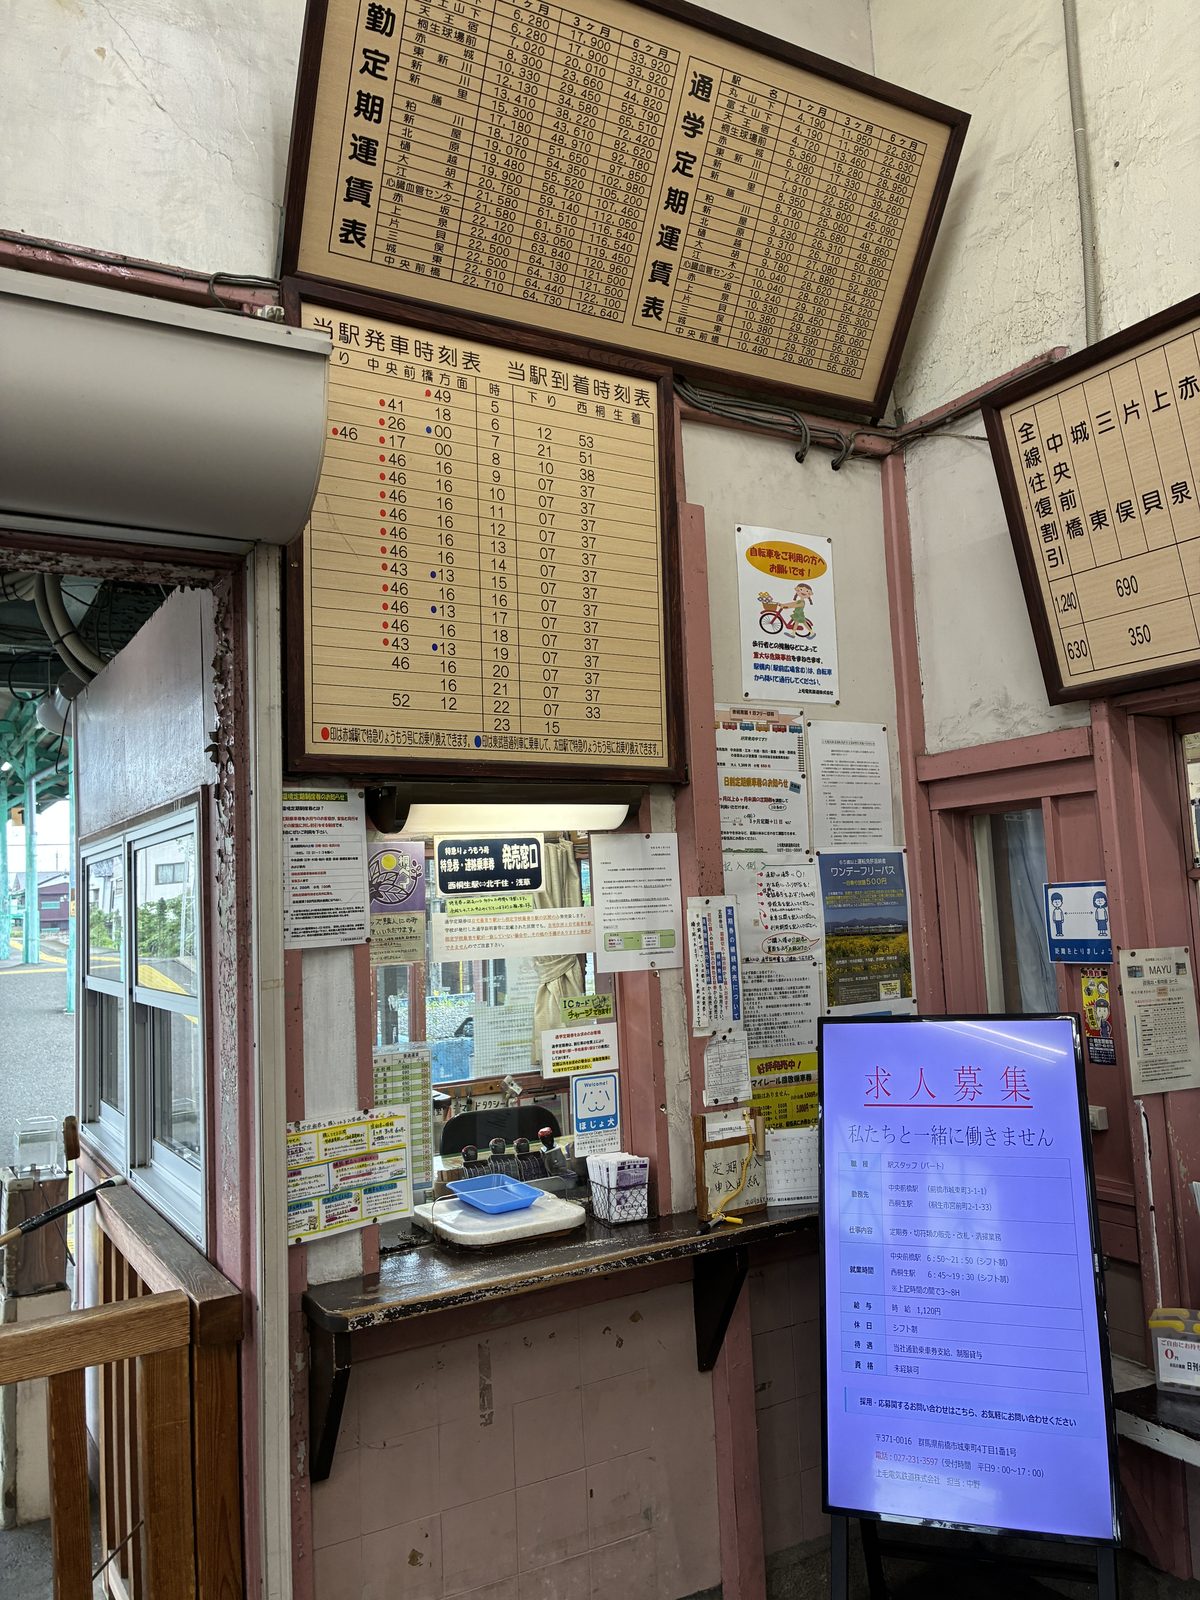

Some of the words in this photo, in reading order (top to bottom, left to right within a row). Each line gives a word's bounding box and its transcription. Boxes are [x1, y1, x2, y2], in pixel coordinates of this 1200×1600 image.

[417, 18, 476, 46] 桐生球場前
[506, 49, 542, 69] 8,300
[562, 68, 603, 89] 23,660
[623, 90, 662, 109] 44,820
[788, 146, 817, 163] 5,360
[833, 162, 863, 179] 15,280
[876, 177, 907, 194] 28,950
[641, 71, 713, 321] 通学定期運賃表
[385, 177, 459, 202] 心臓血管センター
[474, 201, 516, 221] 21,580
[535, 218, 575, 237] 61,510
[589, 234, 632, 252] 116,540
[384, 256, 440, 277] 中央前橋
[462, 274, 503, 292] 22,710
[522, 289, 561, 306] 64,730
[576, 302, 618, 319] 122,640
[313, 317, 480, 372] 当駅発車時刻表
[508, 361, 650, 408] 当駅到着時刻表
[737, 341, 768, 355] 10,490
[782, 352, 813, 365] 29,900
[826, 362, 856, 375] 56,650
[367, 357, 467, 389] 中央前橋方面
[489, 382, 499, 396] 時
[577, 400, 640, 425] 西桐生着
[434, 389, 451, 403] 49
[491, 400, 499, 413] 5
[388, 398, 402, 412] 41
[435, 407, 451, 421] 18
[491, 418, 499, 430] 6
[537, 426, 552, 440] 12
[578, 434, 593, 448] 53
[339, 426, 357, 440] 46
[389, 435, 405, 448] 17
[434, 442, 452, 457] 00
[492, 452, 500, 465] 8
[538, 461, 553, 474] 10
[579, 468, 594, 481] 38
[388, 416, 405, 431] 26
[434, 424, 451, 439] 00
[491, 434, 499, 447] 7
[537, 443, 550, 457] 21
[579, 451, 592, 464] 51
[388, 471, 406, 485] 46
[436, 478, 452, 492] 16
[489, 487, 505, 501] 10
[538, 495, 554, 508] 07
[580, 501, 595, 515] 37
[1018, 422, 1064, 568] 全線往復割引
[1046, 433, 1084, 539] 中央前橋
[749, 546, 825, 566] 自転車をご利用の方へ
[769, 564, 812, 577] お願いです！
[390, 562, 407, 576] 43
[438, 568, 454, 582] 13
[492, 576, 507, 589] 15
[540, 581, 556, 594] 07
[582, 586, 597, 599] 37
[1055, 591, 1077, 613] 1,240
[1115, 575, 1138, 597] 690
[1067, 639, 1087, 659] 630
[1128, 624, 1151, 646] 350
[392, 693, 410, 707] 52
[441, 697, 456, 710] 12
[493, 700, 509, 713] 22
[543, 703, 559, 716] 07
[585, 706, 600, 718] 33
[494, 718, 510, 731] 23
[545, 721, 559, 733] 15
[444, 846, 490, 856] 特急りょうもう号
[501, 843, 539, 870] 発売窓口
[830, 865, 895, 877] ワンデーフリーパス
[1149, 964, 1172, 976] MAYU
[563, 999, 590, 1009] ICカード
[757, 1059, 802, 1075] 好評発売中！
[583, 1080, 609, 1088] Welcome!
[864, 1065, 1030, 1102] 求人募集
[579, 1117, 616, 1131] ほじょ犬
[847, 1123, 1054, 1147] 私たちと一緒に働きません
[849, 1265, 874, 1275] 就業時間
[916, 1305, 941, 1316] 1,120円
[892, 1323, 918, 1334] シフト制
[893, 1363, 919, 1375] 未経験可
[1187, 1361, 1200, 1372] 日刊
